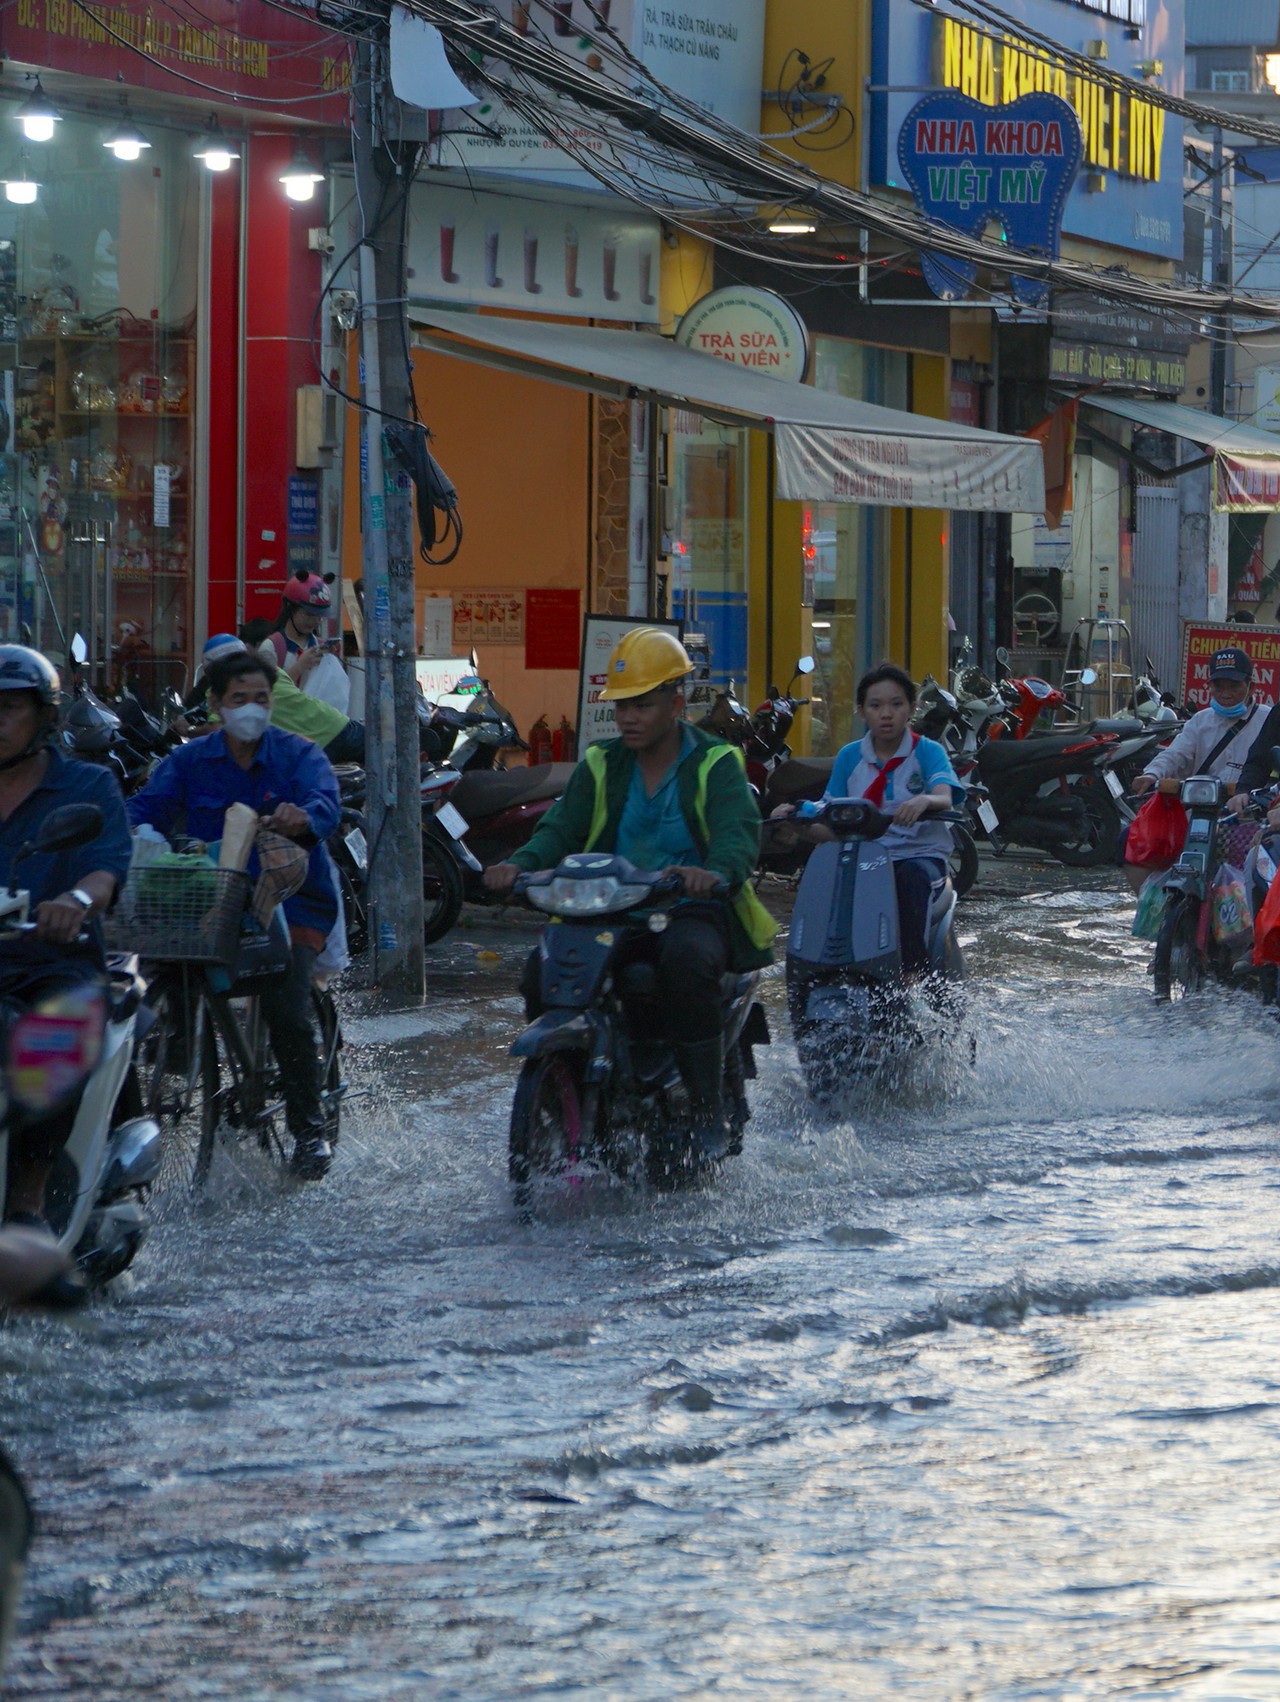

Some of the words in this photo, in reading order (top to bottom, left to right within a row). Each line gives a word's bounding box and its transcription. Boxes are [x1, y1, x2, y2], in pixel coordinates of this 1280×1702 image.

[915, 119, 977, 156] NHA
[985, 119, 1064, 156] KHOA
[928, 160, 992, 210] VIỆT
[1000, 160, 1047, 204] MỸ
[699, 331, 736, 349] TRÀ
[739, 330, 778, 349] SỮA
[740, 348, 781, 367] VIÊN
[1250, 636, 1280, 661] TIỀN
